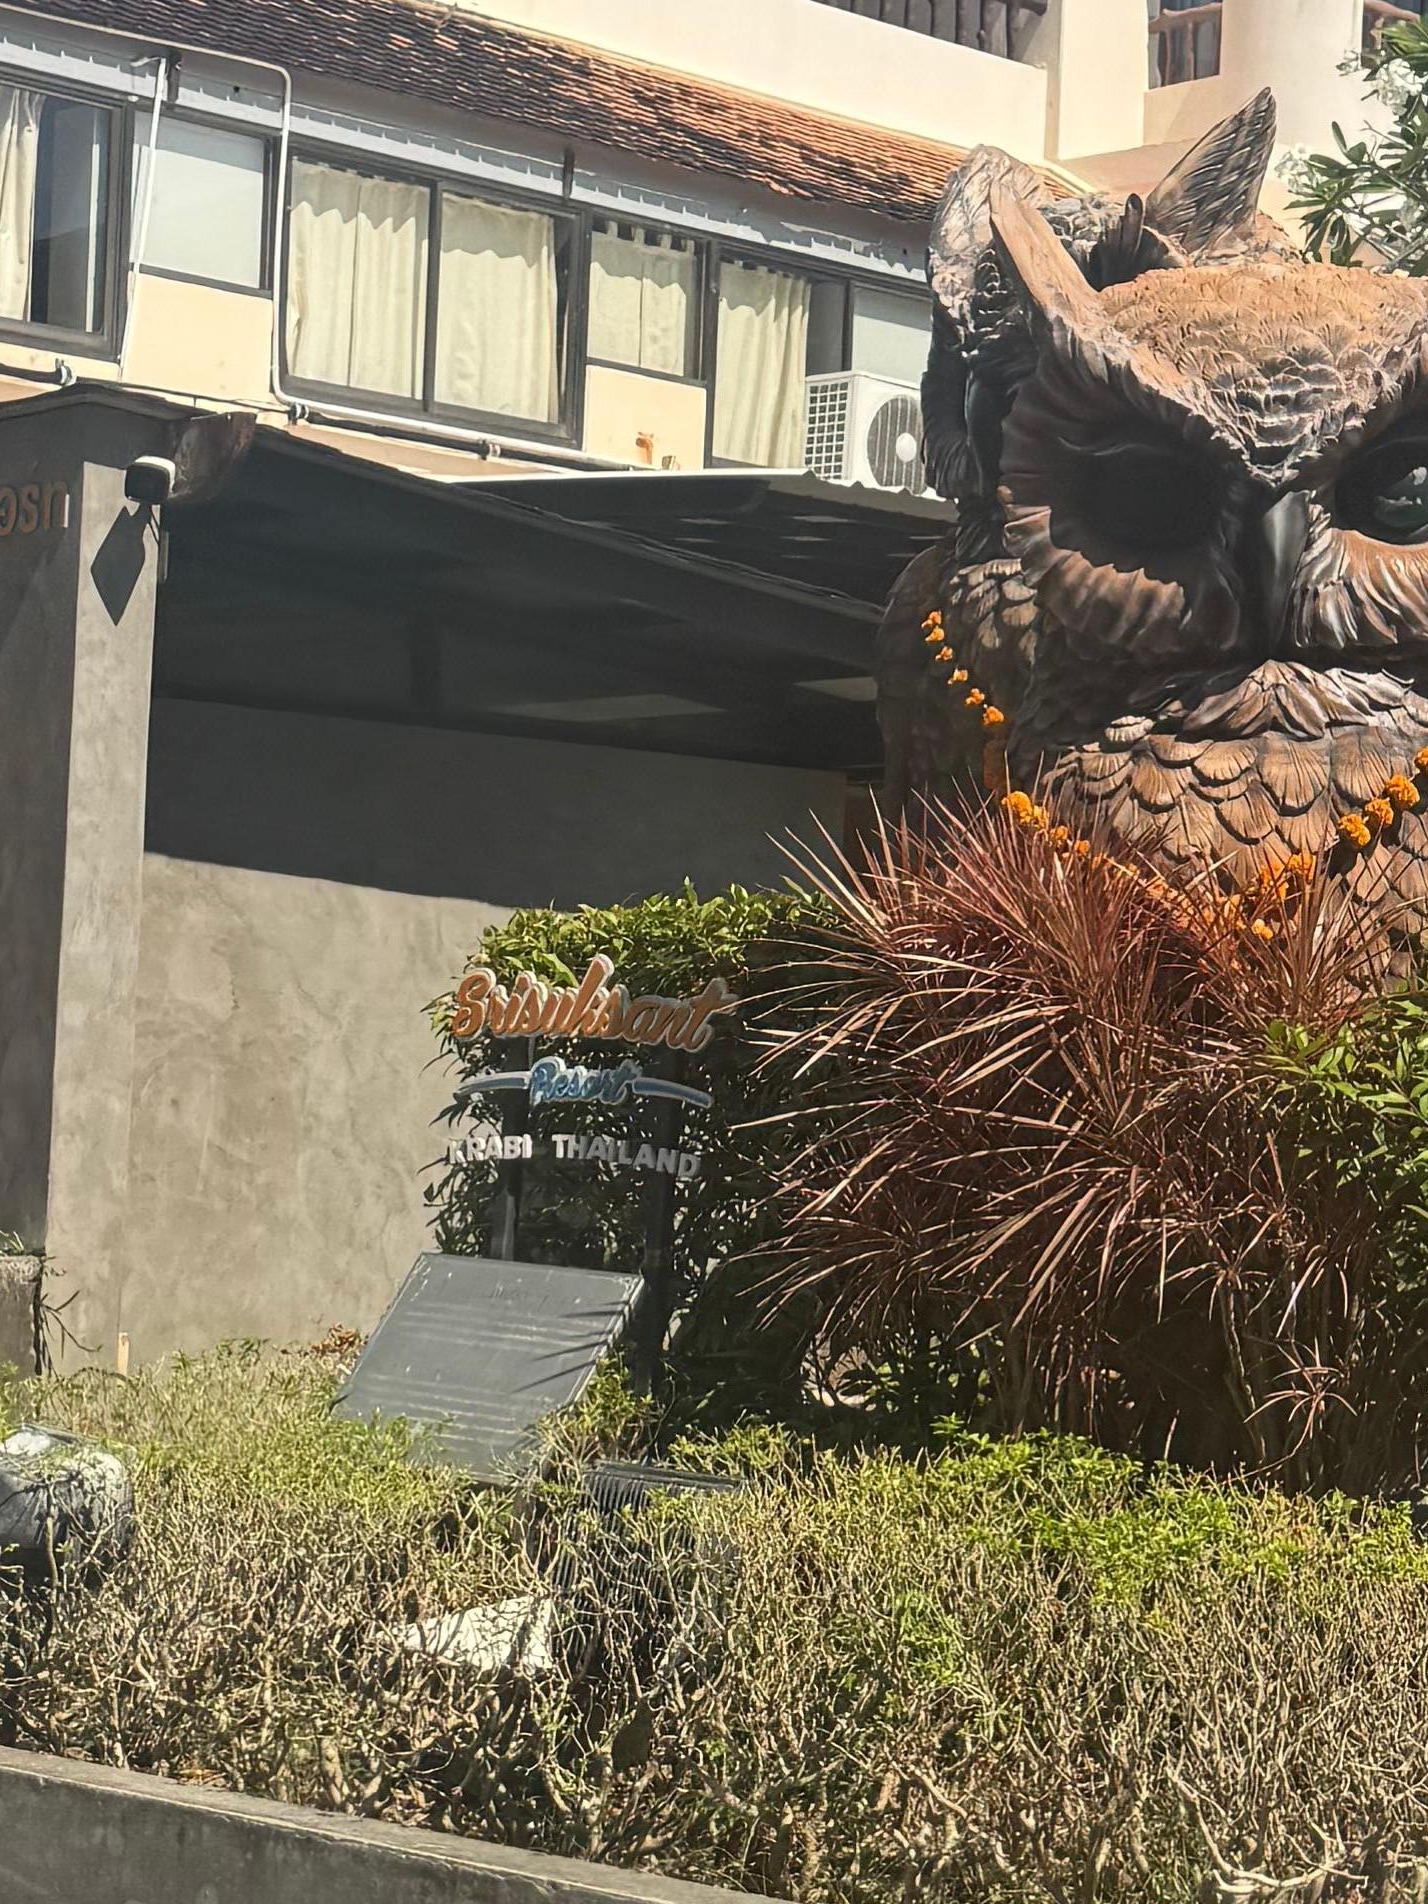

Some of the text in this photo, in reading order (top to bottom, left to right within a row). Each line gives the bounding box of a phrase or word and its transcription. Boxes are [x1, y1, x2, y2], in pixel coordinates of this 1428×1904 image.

[451, 953, 740, 1053] Srisuksant
[529, 1055, 642, 1106] Resort
[448, 1133, 702, 1180] KRABI THAILAND
